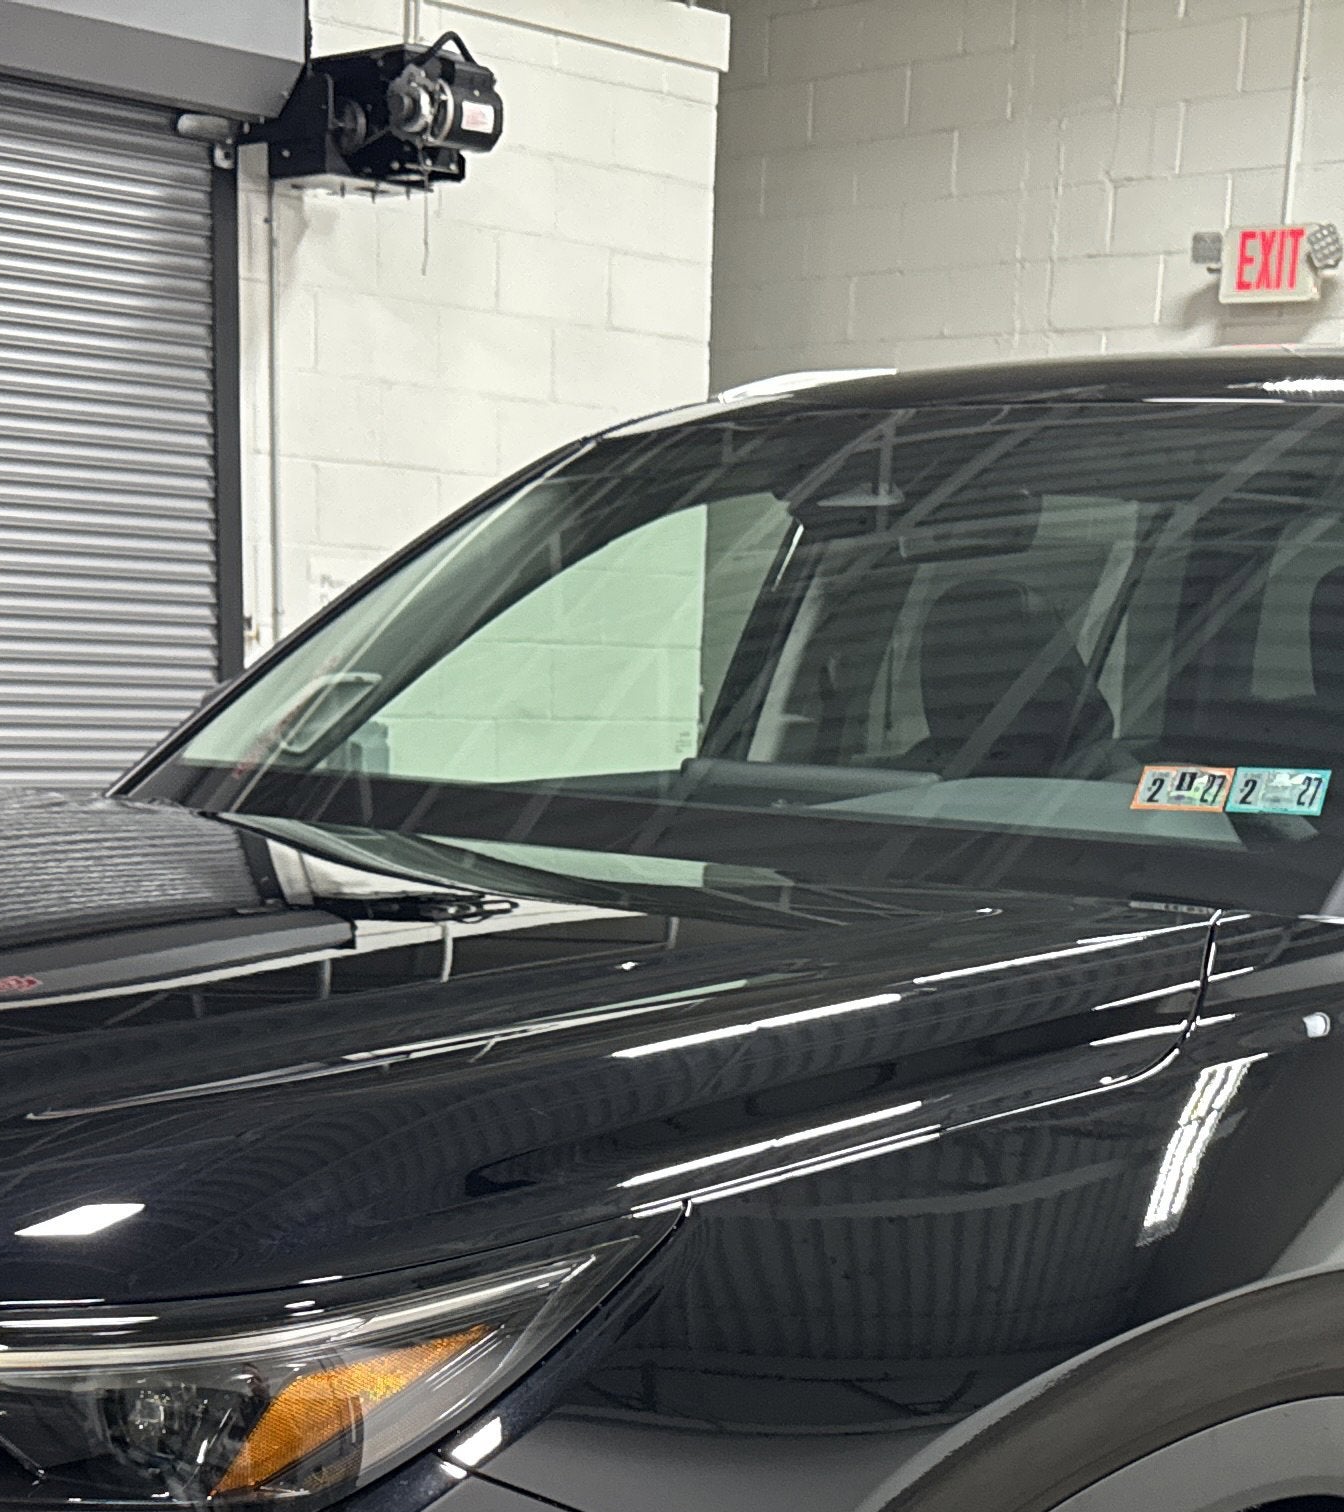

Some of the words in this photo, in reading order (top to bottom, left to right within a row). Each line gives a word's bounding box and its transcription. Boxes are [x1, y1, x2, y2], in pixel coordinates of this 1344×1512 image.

[1236, 228, 1305, 291] EXIT
[1146, 777, 1165, 803] 2
[1199, 773, 1227, 807] 27
[1239, 779, 1258, 805] 2
[1296, 776, 1323, 808] 27
